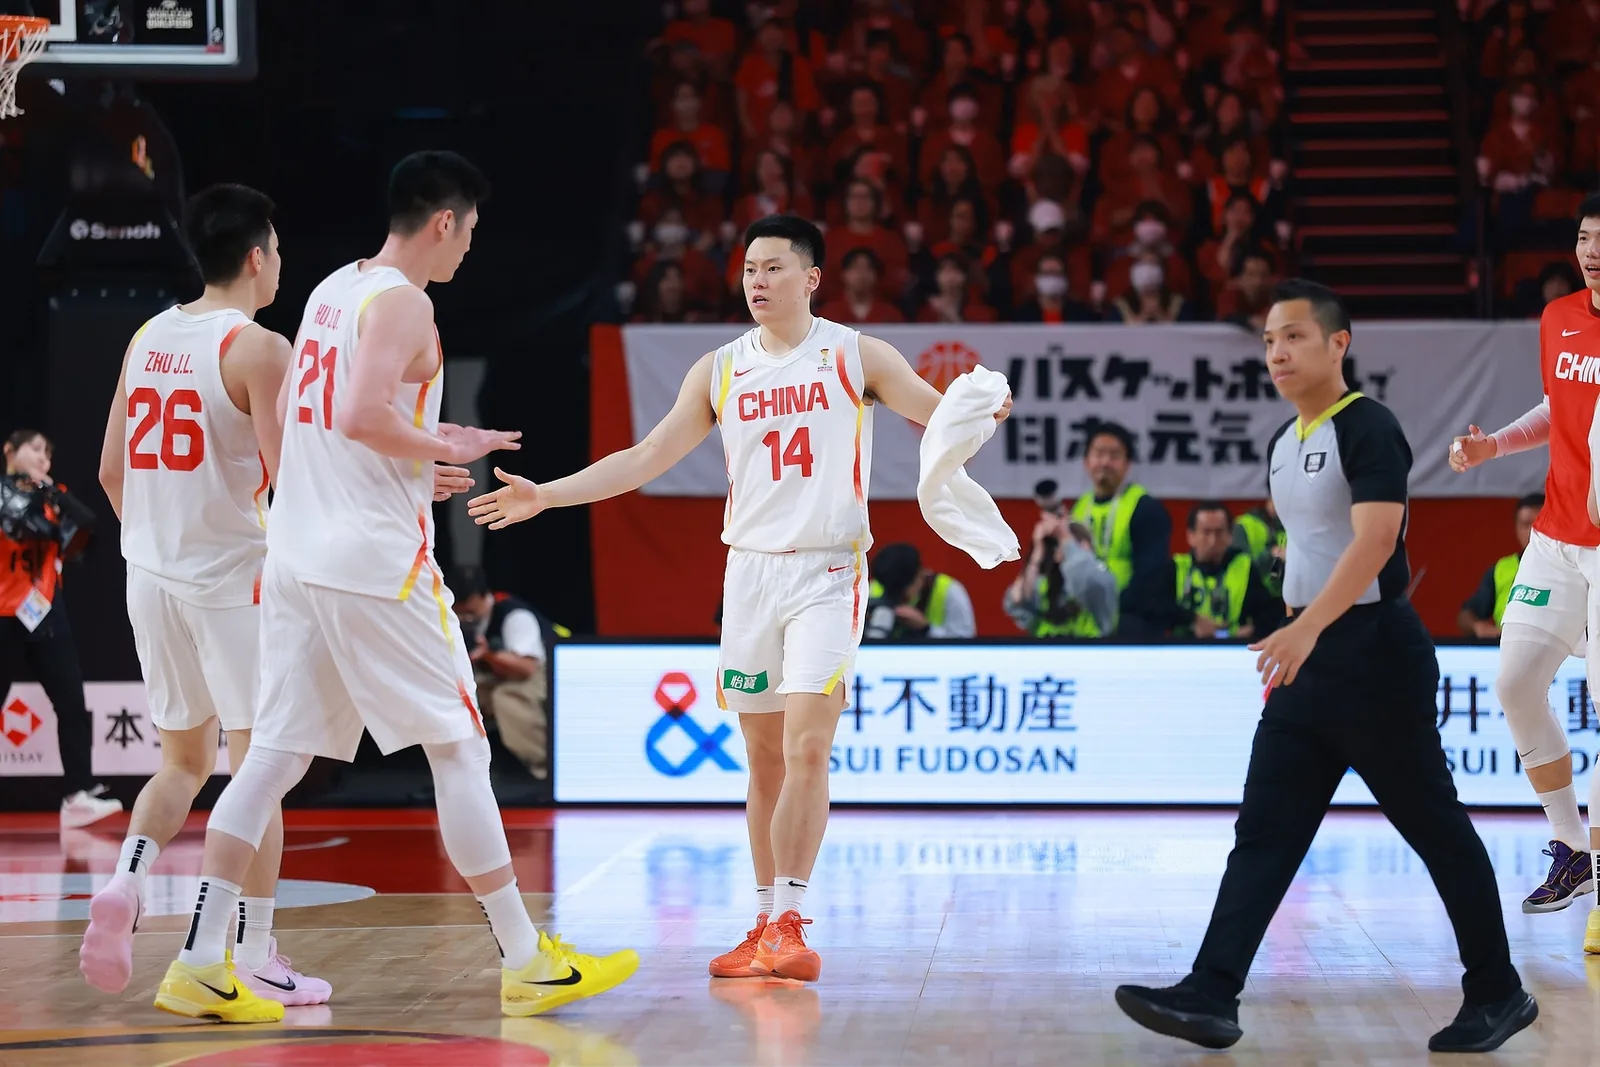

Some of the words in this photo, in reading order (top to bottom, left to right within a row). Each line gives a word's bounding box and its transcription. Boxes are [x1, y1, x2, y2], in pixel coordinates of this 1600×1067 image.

[314, 303, 331, 325] HU
[145, 351, 173, 373] ZHU
[173, 353, 193, 374] J.L.
[298, 339, 337, 431] 21
[738, 381, 829, 422] CHINA
[128, 387, 204, 471] 26
[762, 426, 813, 481] 14
[0, 752, 44, 764] ISSAY
[900, 746, 1078, 773] FUDOSAN
